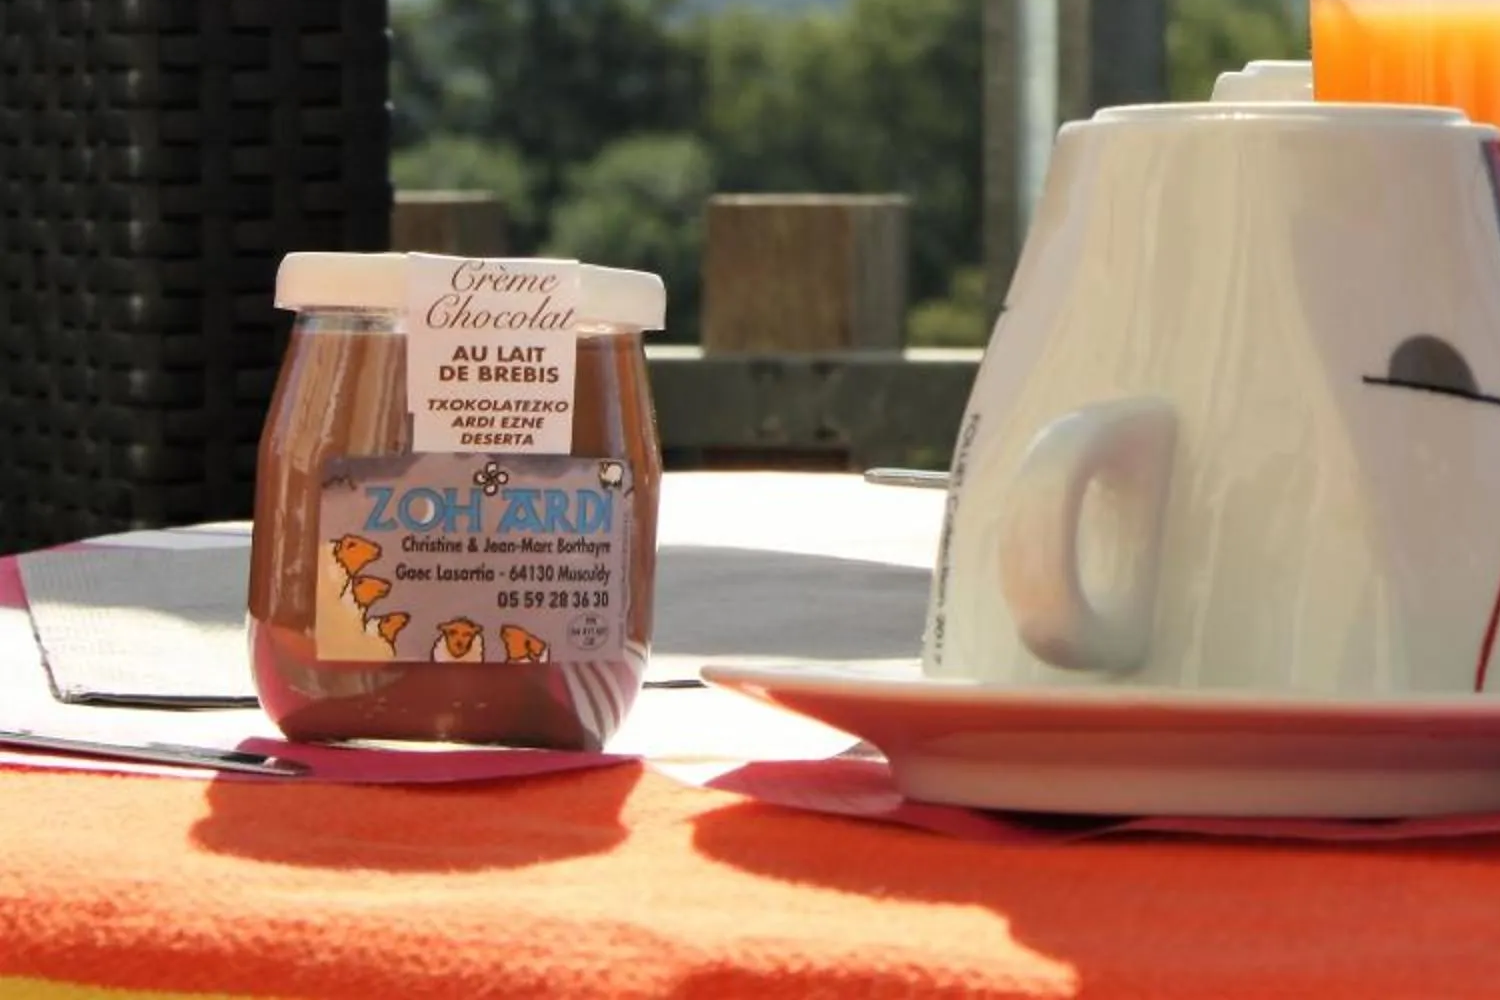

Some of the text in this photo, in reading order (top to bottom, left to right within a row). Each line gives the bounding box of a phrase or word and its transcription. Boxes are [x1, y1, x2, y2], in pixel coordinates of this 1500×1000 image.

[451, 260, 560, 293] Crème
[426, 294, 577, 330] Chocolat
[452, 346, 546, 363] AU LAIT
[439, 366, 560, 383] DE BREBIS
[428, 399, 568, 413] TXOKOLATEZKO
[452, 416, 545, 429] ARDI EZNE
[461, 433, 534, 446] DESERTA
[402, 536, 463, 553] Christine
[467, 538, 479, 553] &
[483, 538, 553, 555] Jean-Marc
[509, 564, 554, 581] 64130
[497, 591, 609, 608] 05 59 28 36 30
